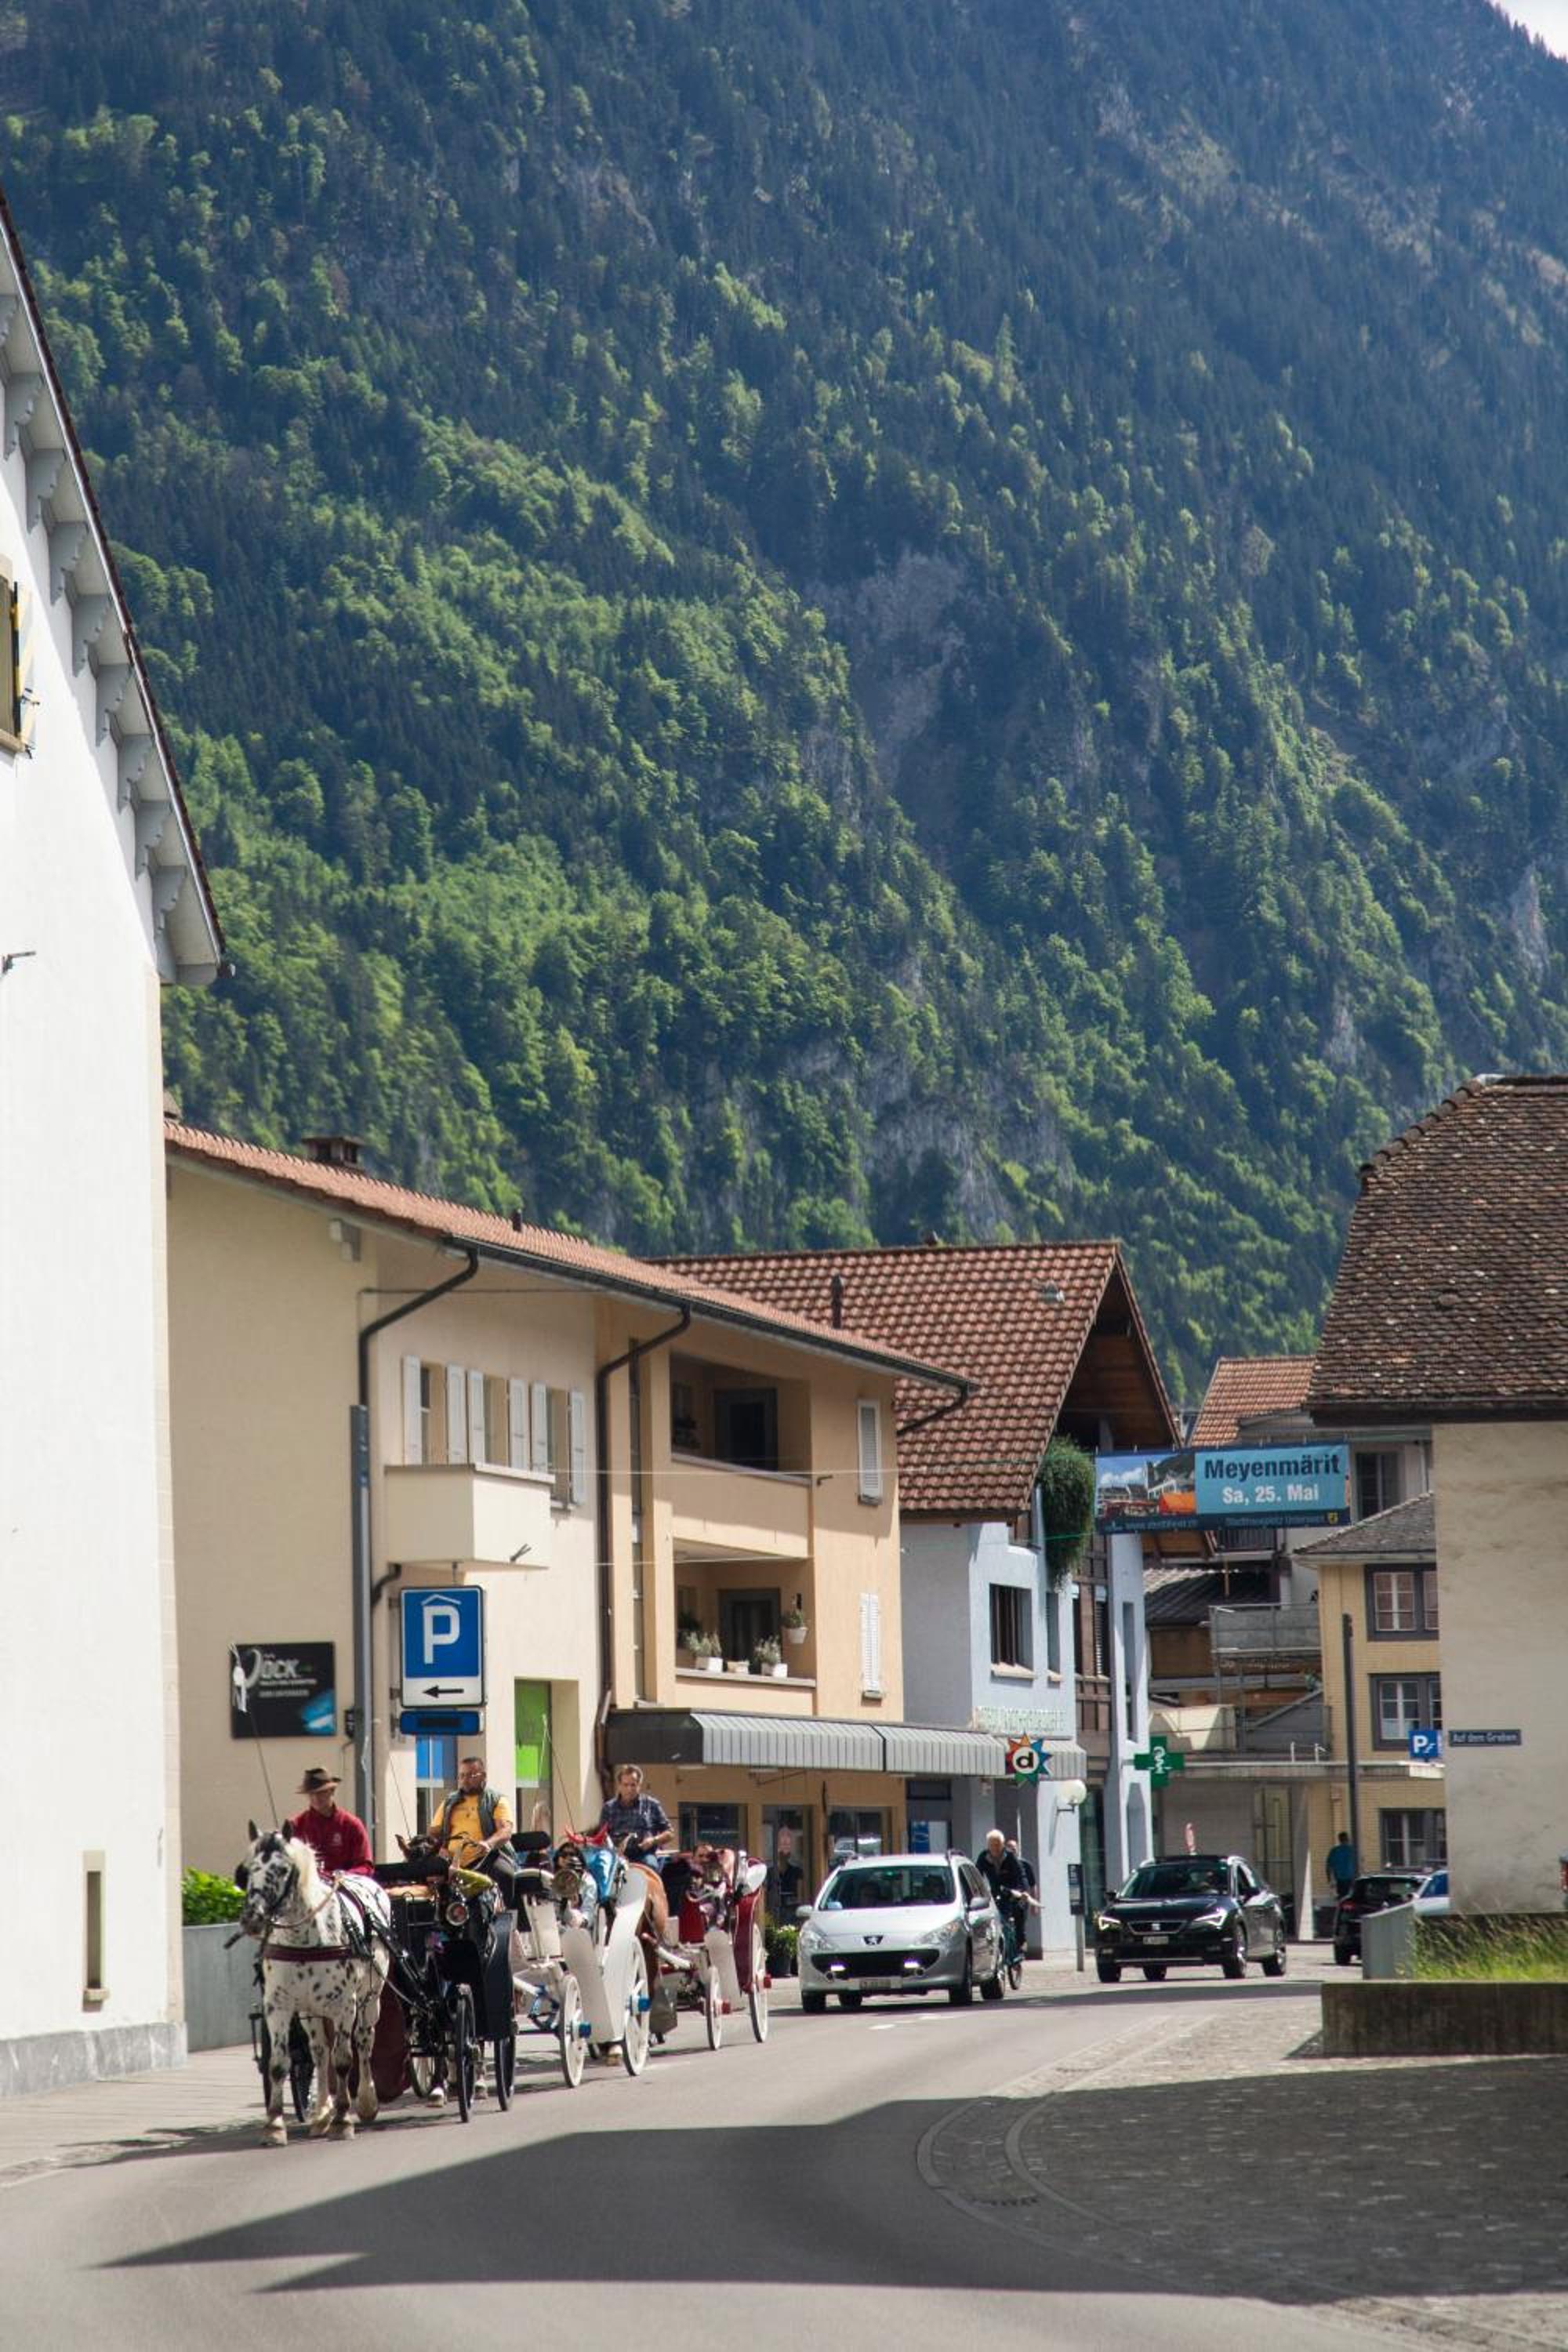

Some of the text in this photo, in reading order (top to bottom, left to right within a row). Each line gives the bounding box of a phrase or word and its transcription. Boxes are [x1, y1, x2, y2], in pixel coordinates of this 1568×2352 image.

[1204, 1454, 1341, 1483] Meyenmärit
[1222, 1483, 1319, 1506] Sa, 25. Mai
[423, 1605, 460, 1664] P
[1413, 1735, 1428, 1754] P
